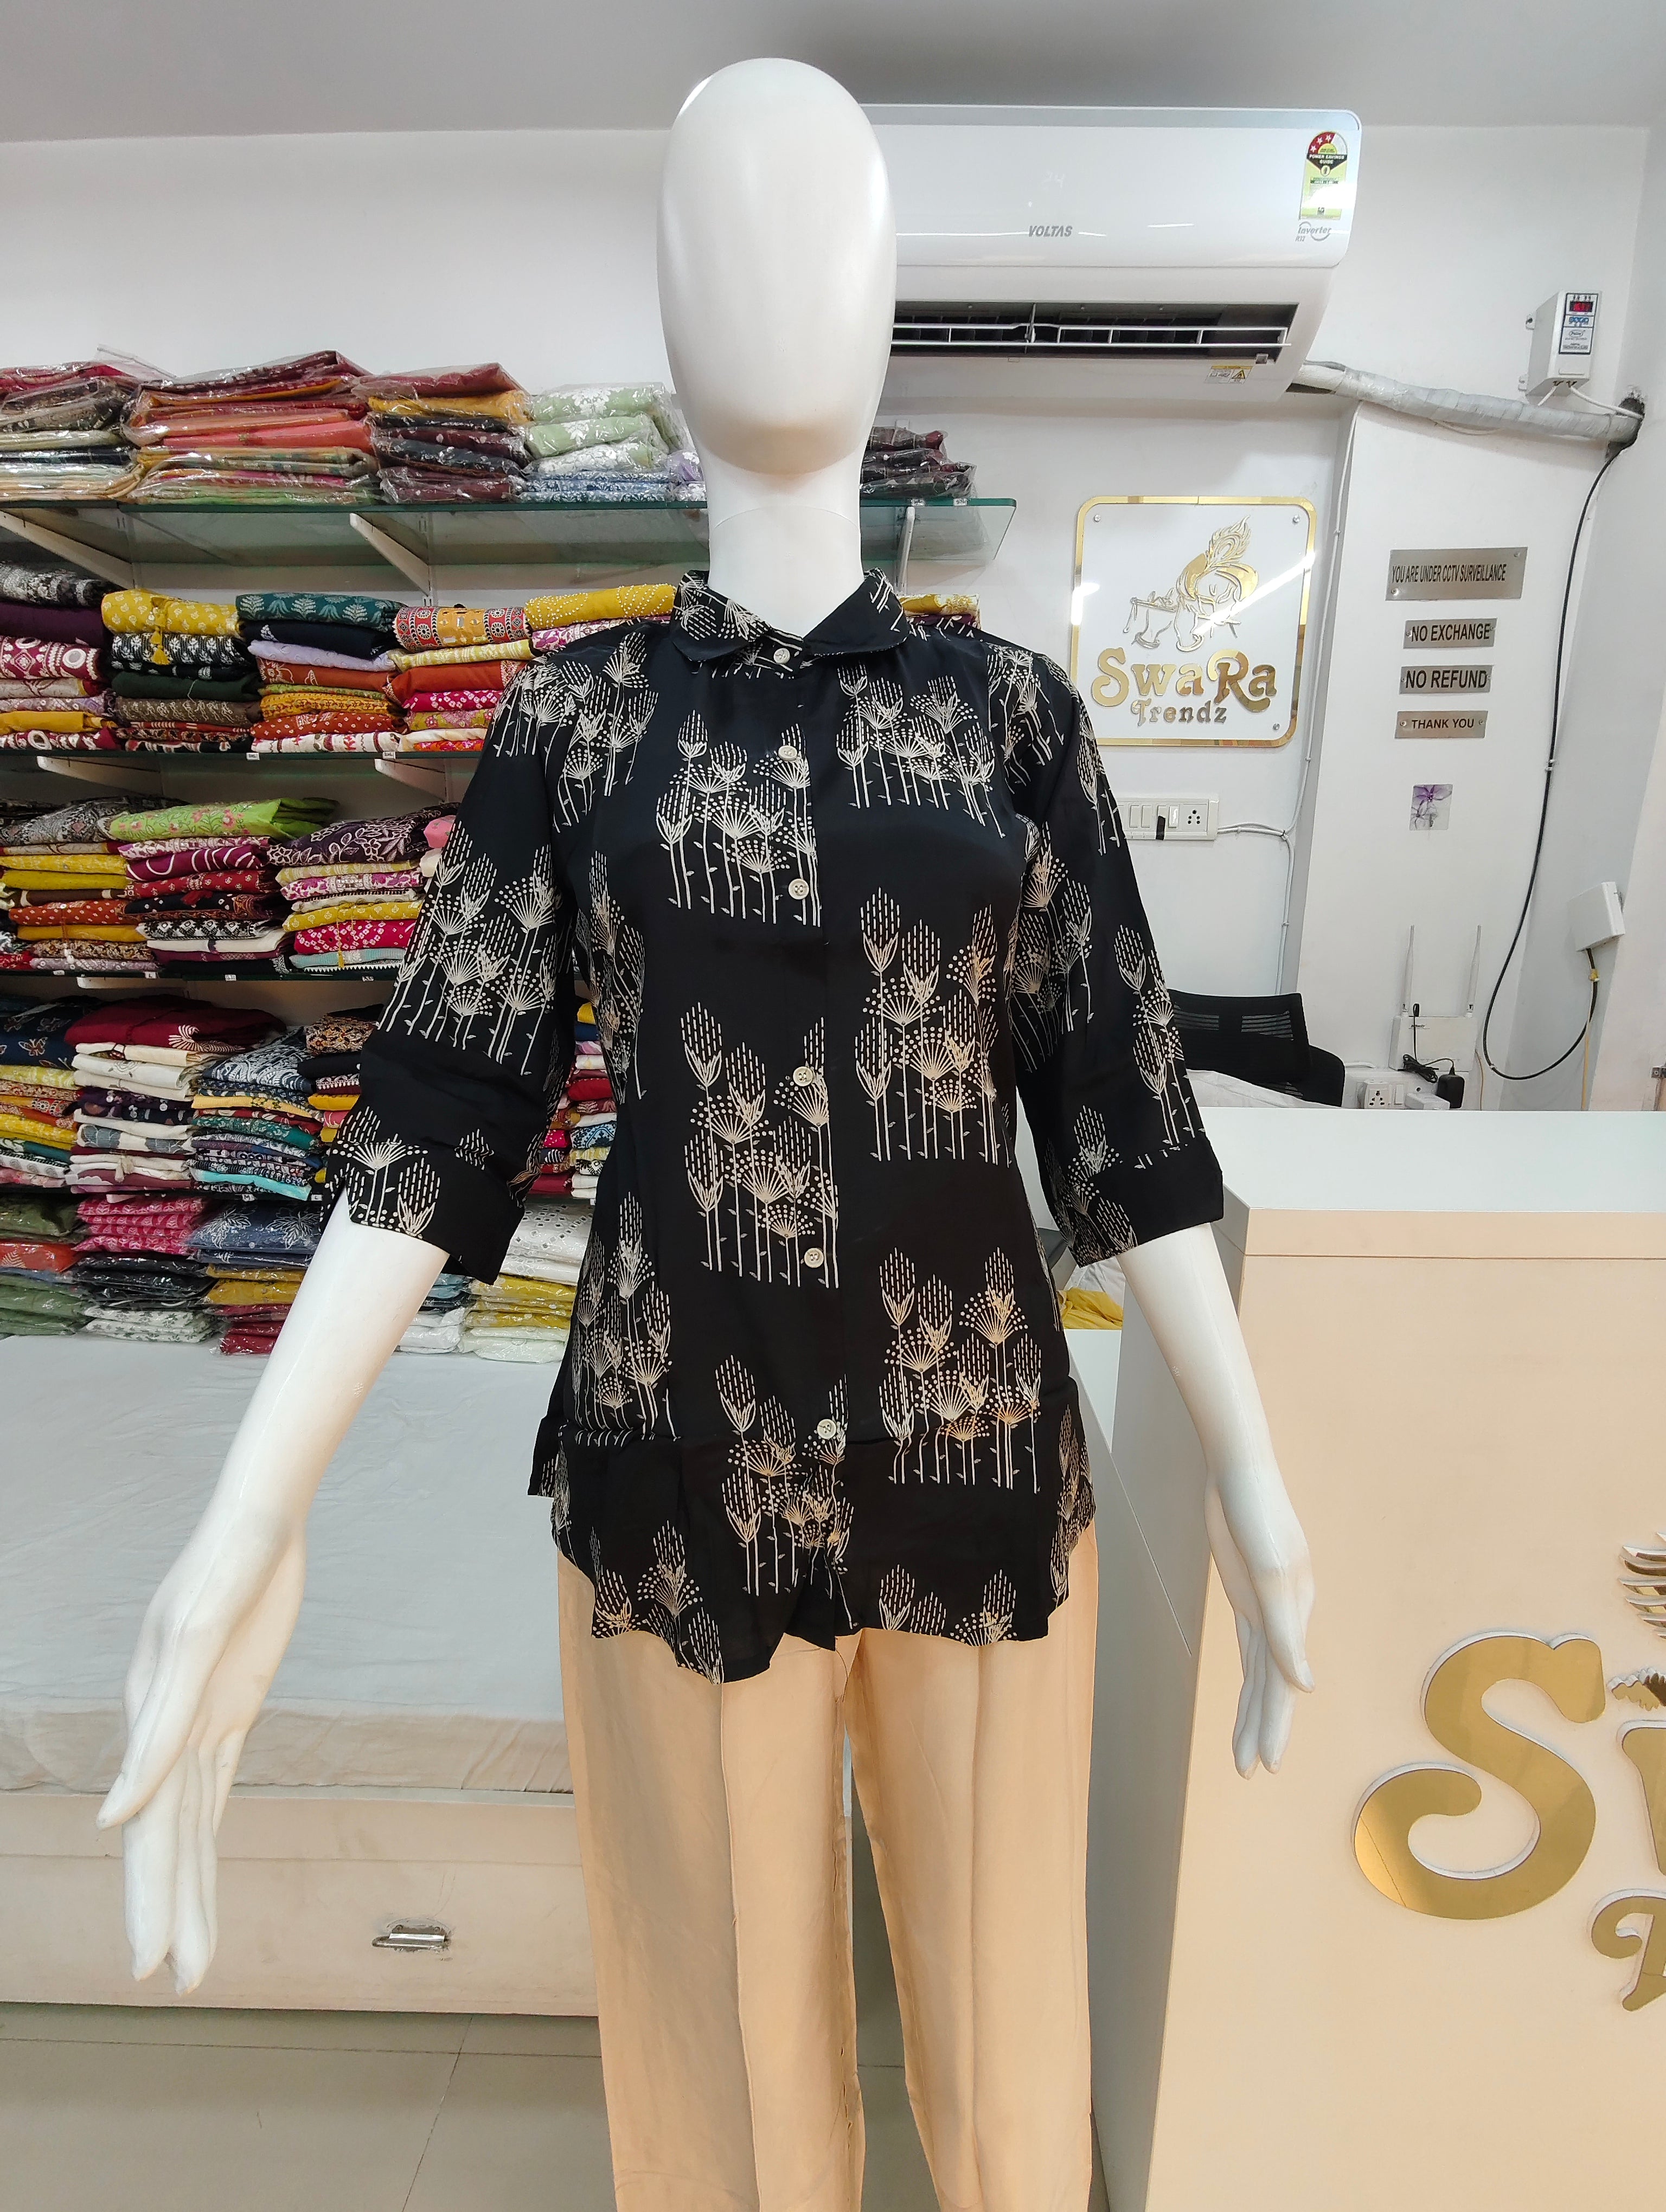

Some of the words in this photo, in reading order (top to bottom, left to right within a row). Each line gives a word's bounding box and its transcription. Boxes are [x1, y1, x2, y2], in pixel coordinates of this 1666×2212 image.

[1028, 225, 1073, 237] VOLTAS
[1392, 565, 1405, 583] YOU
[1405, 565, 1419, 582] ARE
[1420, 565, 1442, 582] UNDER
[1442, 564, 1460, 582] CCTV
[1460, 563, 1507, 582] SURVEILLANCE
[1411, 625, 1428, 642] NO
[1431, 623, 1491, 641] EXCHANGE
[1091, 647, 1278, 713] SwaRa
[1405, 670, 1427, 689] NO
[1431, 670, 1488, 689] REFUND
[1131, 698, 1227, 726] Trendz
[1412, 719, 1450, 729] THANK
[1452, 718, 1475, 729] YOU
